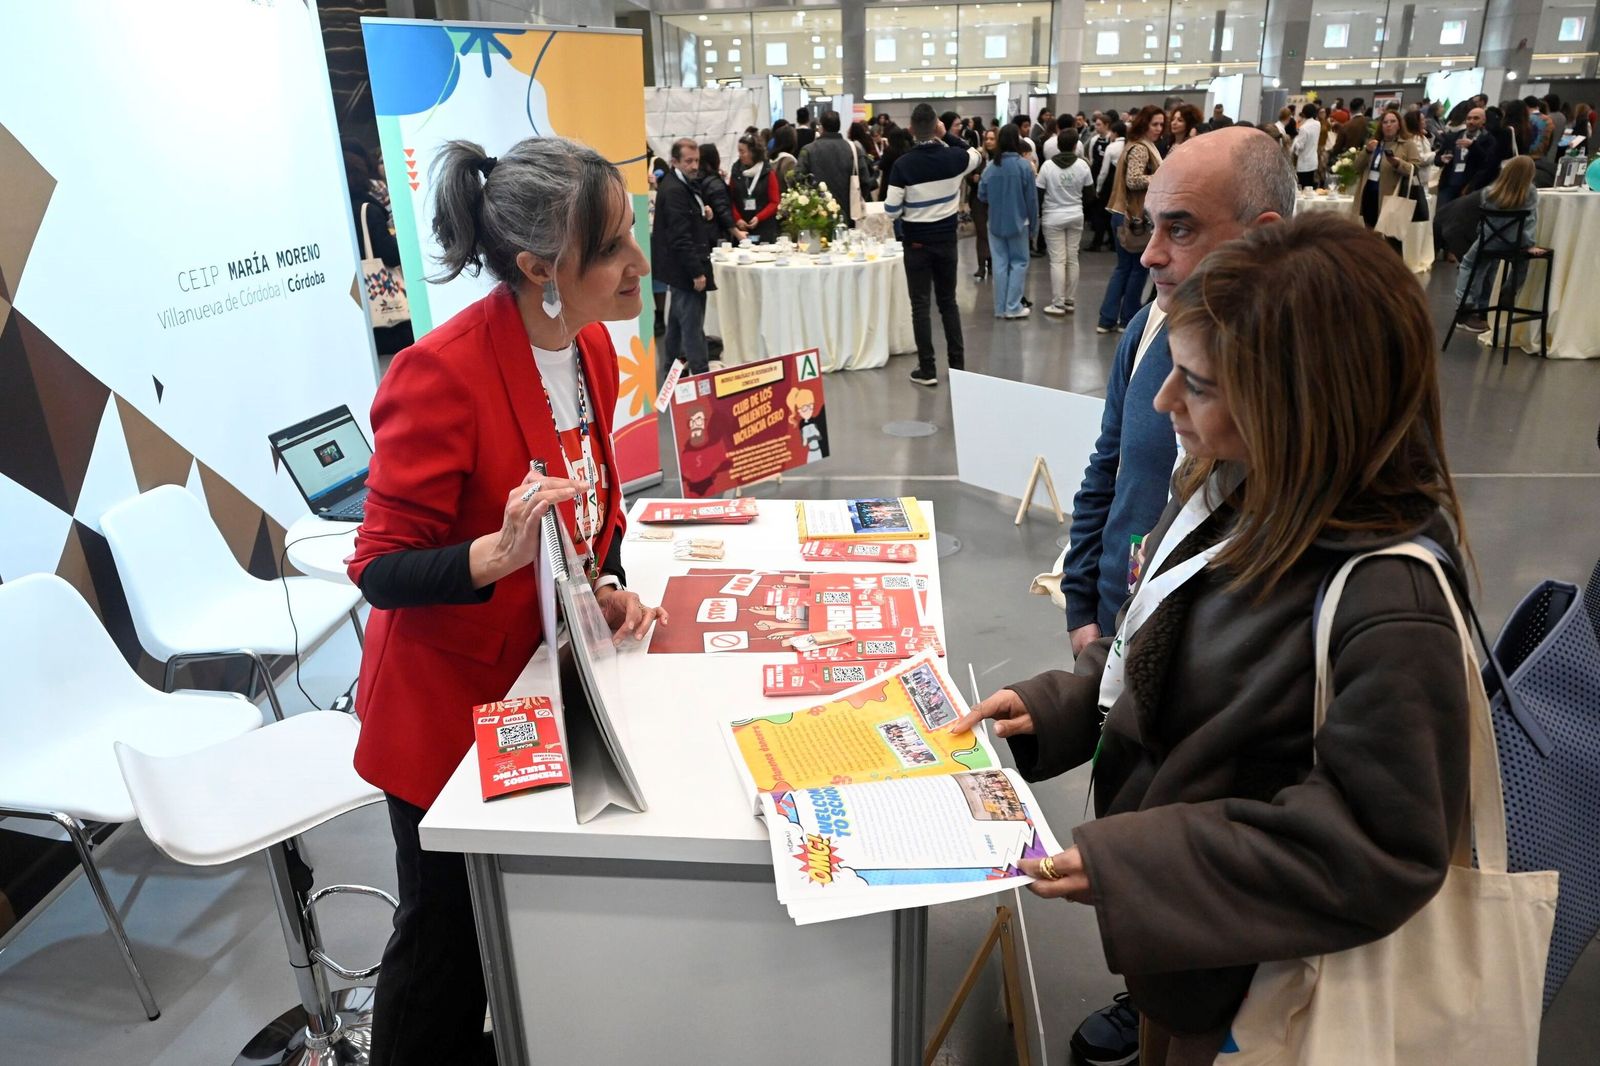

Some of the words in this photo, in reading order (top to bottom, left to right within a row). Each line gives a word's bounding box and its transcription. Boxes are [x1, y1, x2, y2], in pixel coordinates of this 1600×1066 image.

[178, 265, 219, 292] CEIP
[228, 251, 270, 280] MARÍA
[276, 243, 321, 268] MORENO
[157, 301, 224, 329] Villanueva
[225, 294, 238, 311] de
[240, 283, 281, 307] Córdoba
[287, 271, 325, 292] Córdoba
[660, 368, 679, 406] AHORA
[732, 397, 750, 417] CLUB
[750, 393, 762, 410] DE
[761, 386, 773, 405] LOS
[733, 418, 766, 445] VIOLENCIA
[767, 408, 784, 427] CERO
[738, 401, 772, 428] VALIENTES
[730, 577, 753, 591] NO
[706, 600, 728, 619] STOP!
[833, 818, 851, 838] TO
[806, 833, 833, 884] OMG!
